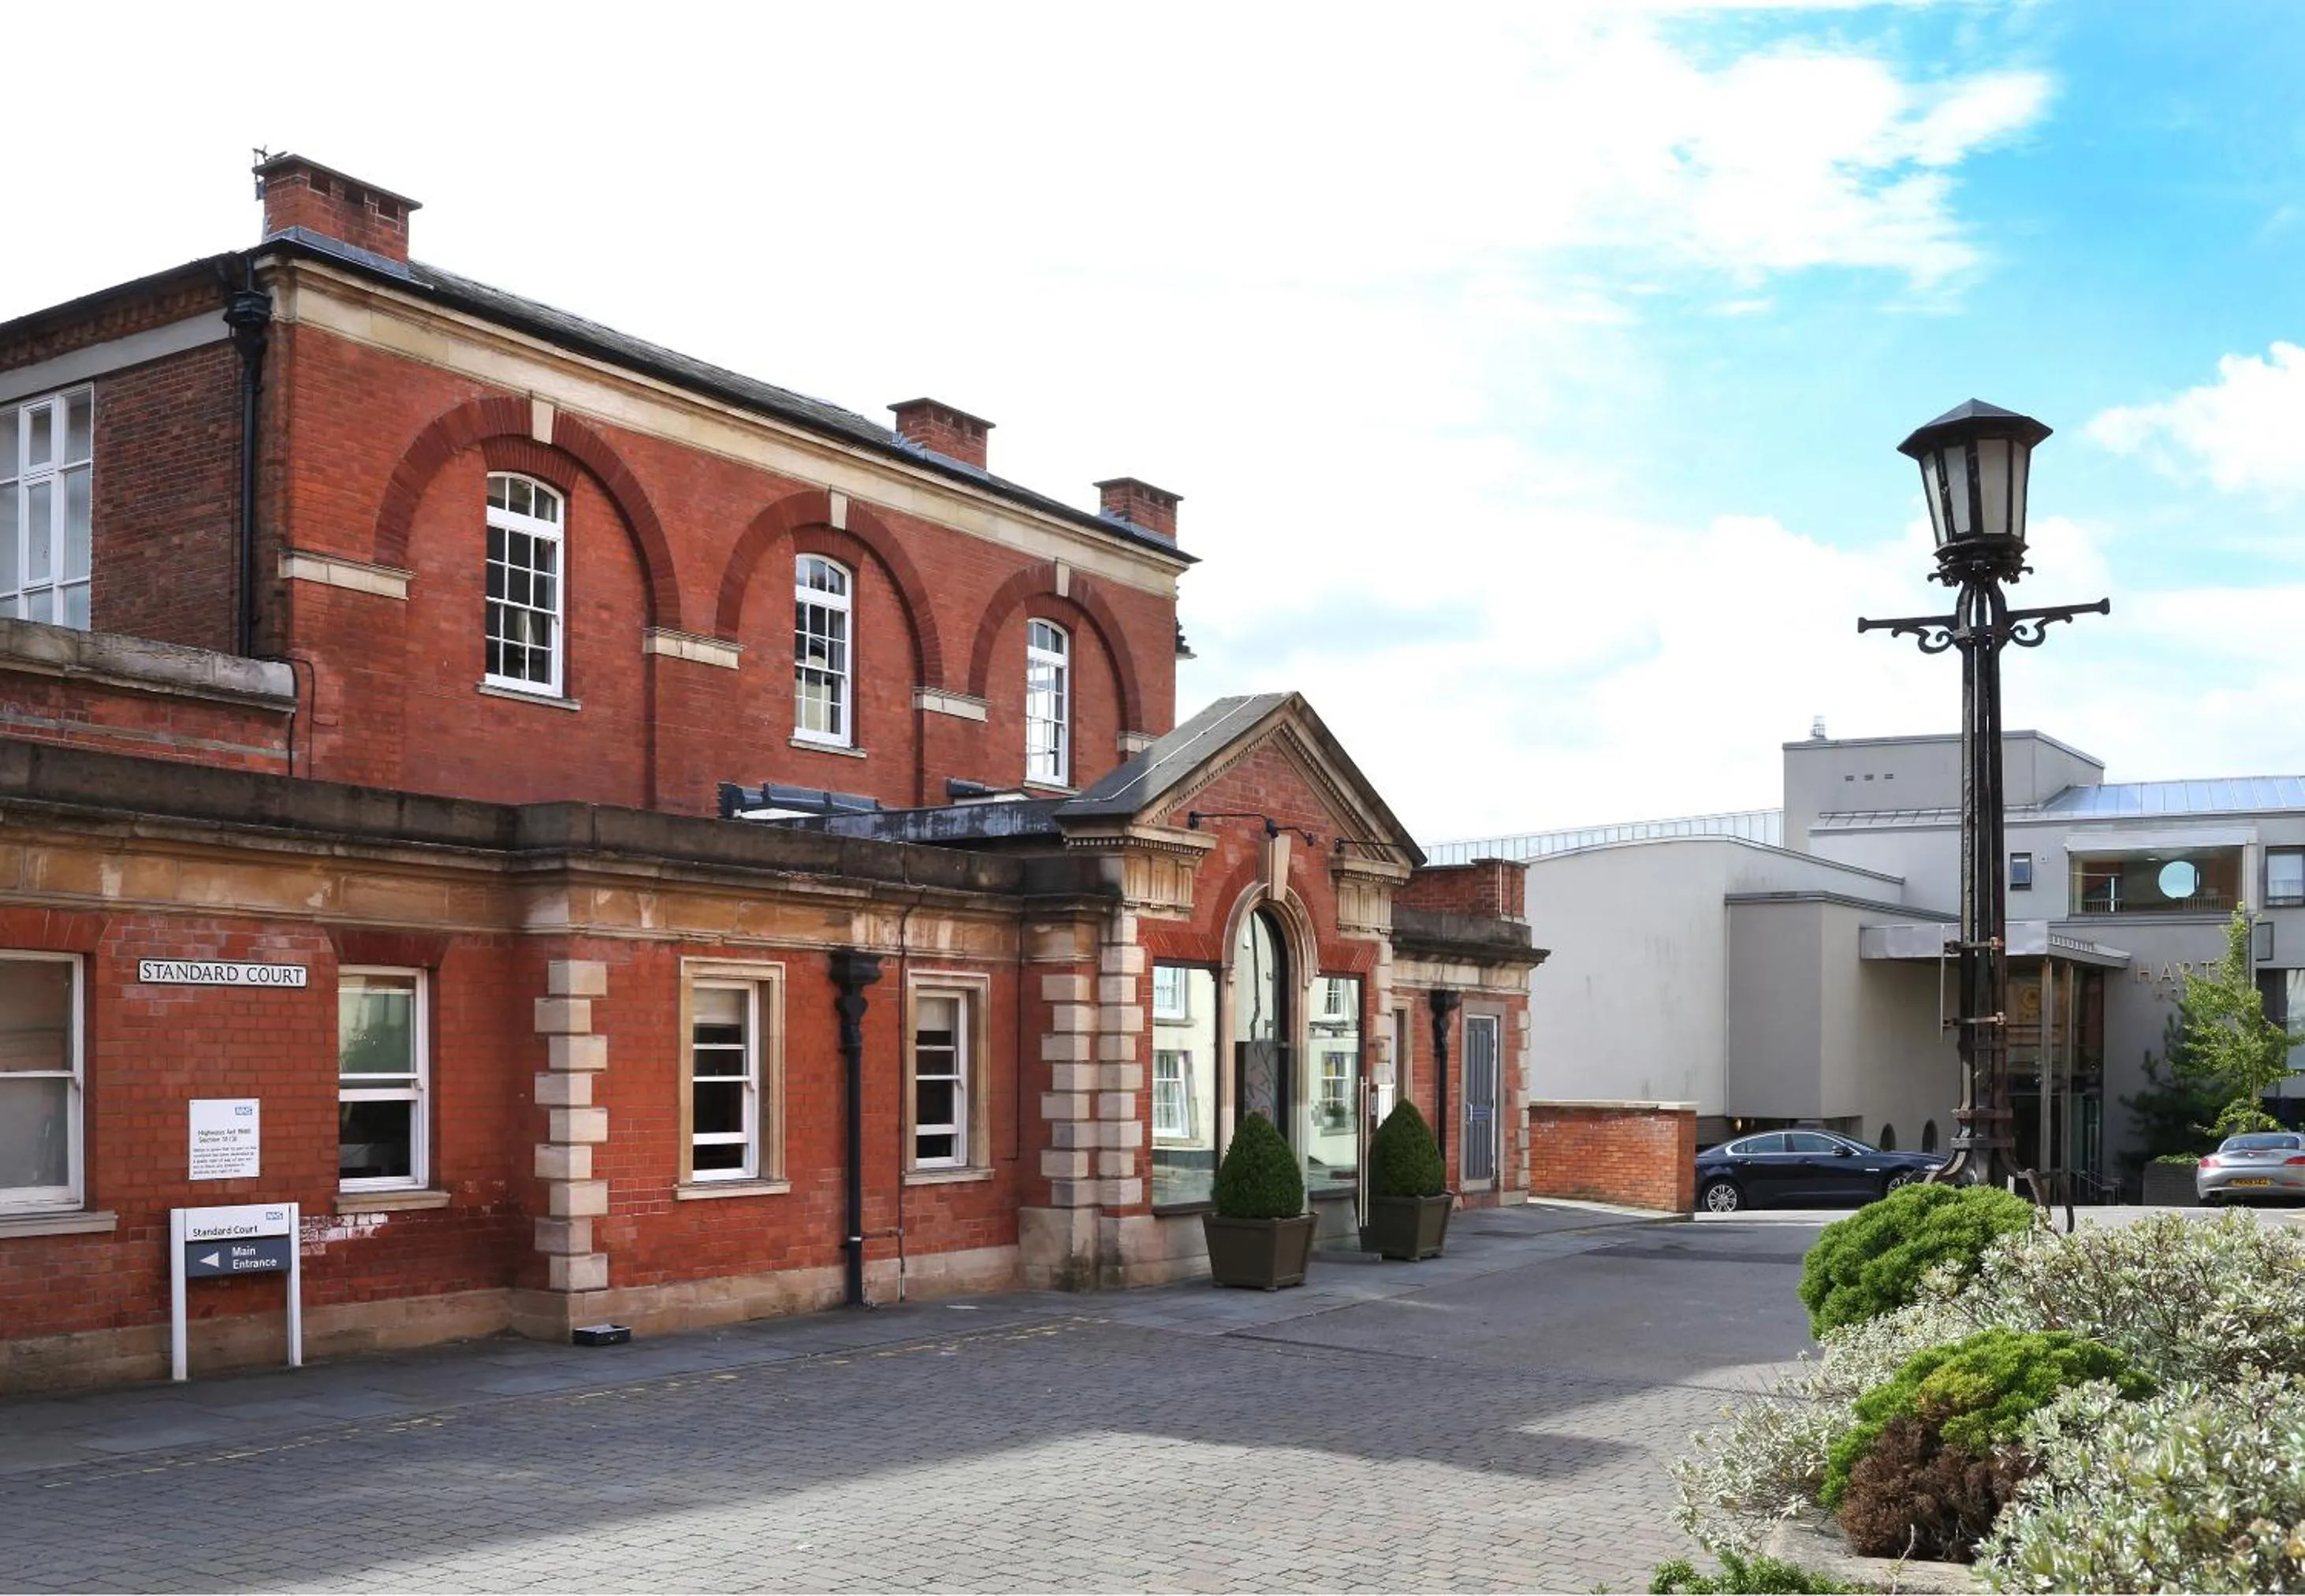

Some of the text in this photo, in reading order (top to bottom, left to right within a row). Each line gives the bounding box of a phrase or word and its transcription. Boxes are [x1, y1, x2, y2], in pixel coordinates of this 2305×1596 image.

[143, 962, 303, 984] STANDARD COURT
[193, 1225, 258, 1237] Standard Court
[232, 1246, 256, 1256] Main
[233, 1258, 277, 1270] Entrance
